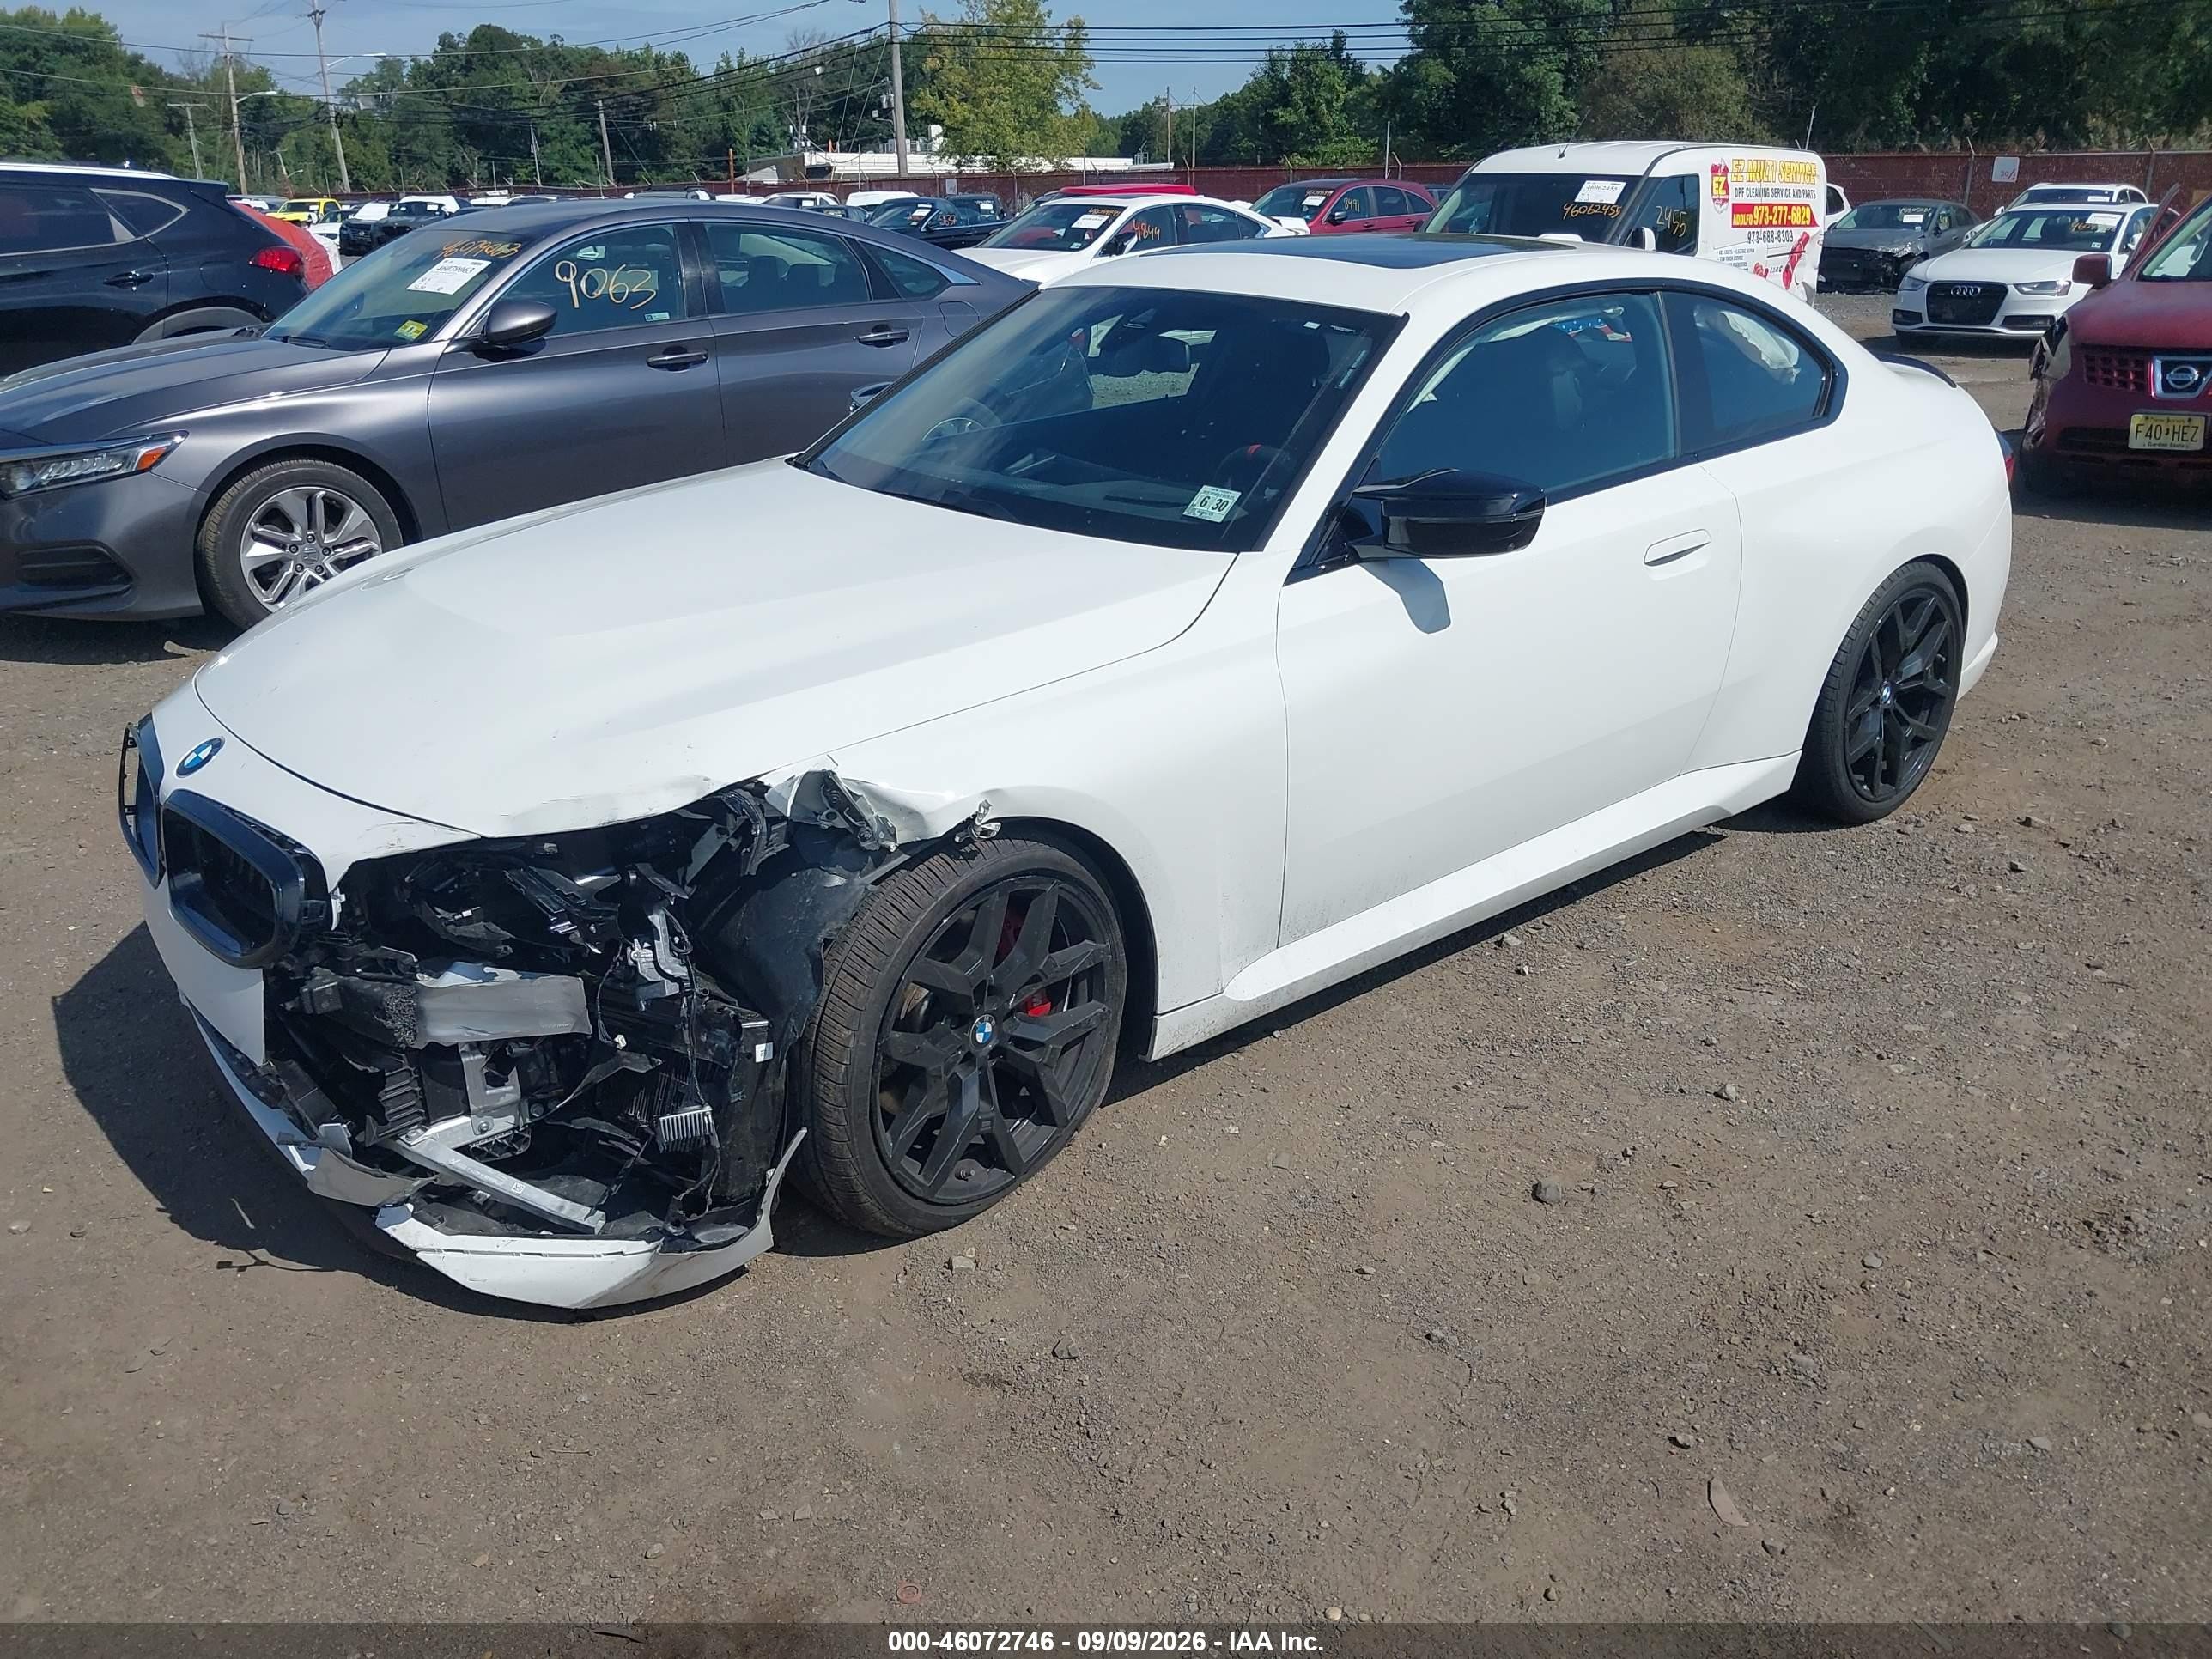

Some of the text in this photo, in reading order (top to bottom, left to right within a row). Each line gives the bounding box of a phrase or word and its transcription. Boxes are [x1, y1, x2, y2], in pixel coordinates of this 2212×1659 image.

[1730, 159, 1817, 185] EZ MULTI SERVICE
[1712, 175, 1727, 196] EZ
[1735, 187, 1816, 200] DPF CLEANING SERVICE AND PARTS
[1655, 205, 1687, 237] 2455
[1753, 205, 1811, 226] 973-277-6829
[1747, 229, 1794, 244] 973-688-8309
[555, 260, 657, 309] 9063
[2135, 423, 2199, 442] F40 HEZ
[1200, 495, 1229, 513] 6 30
